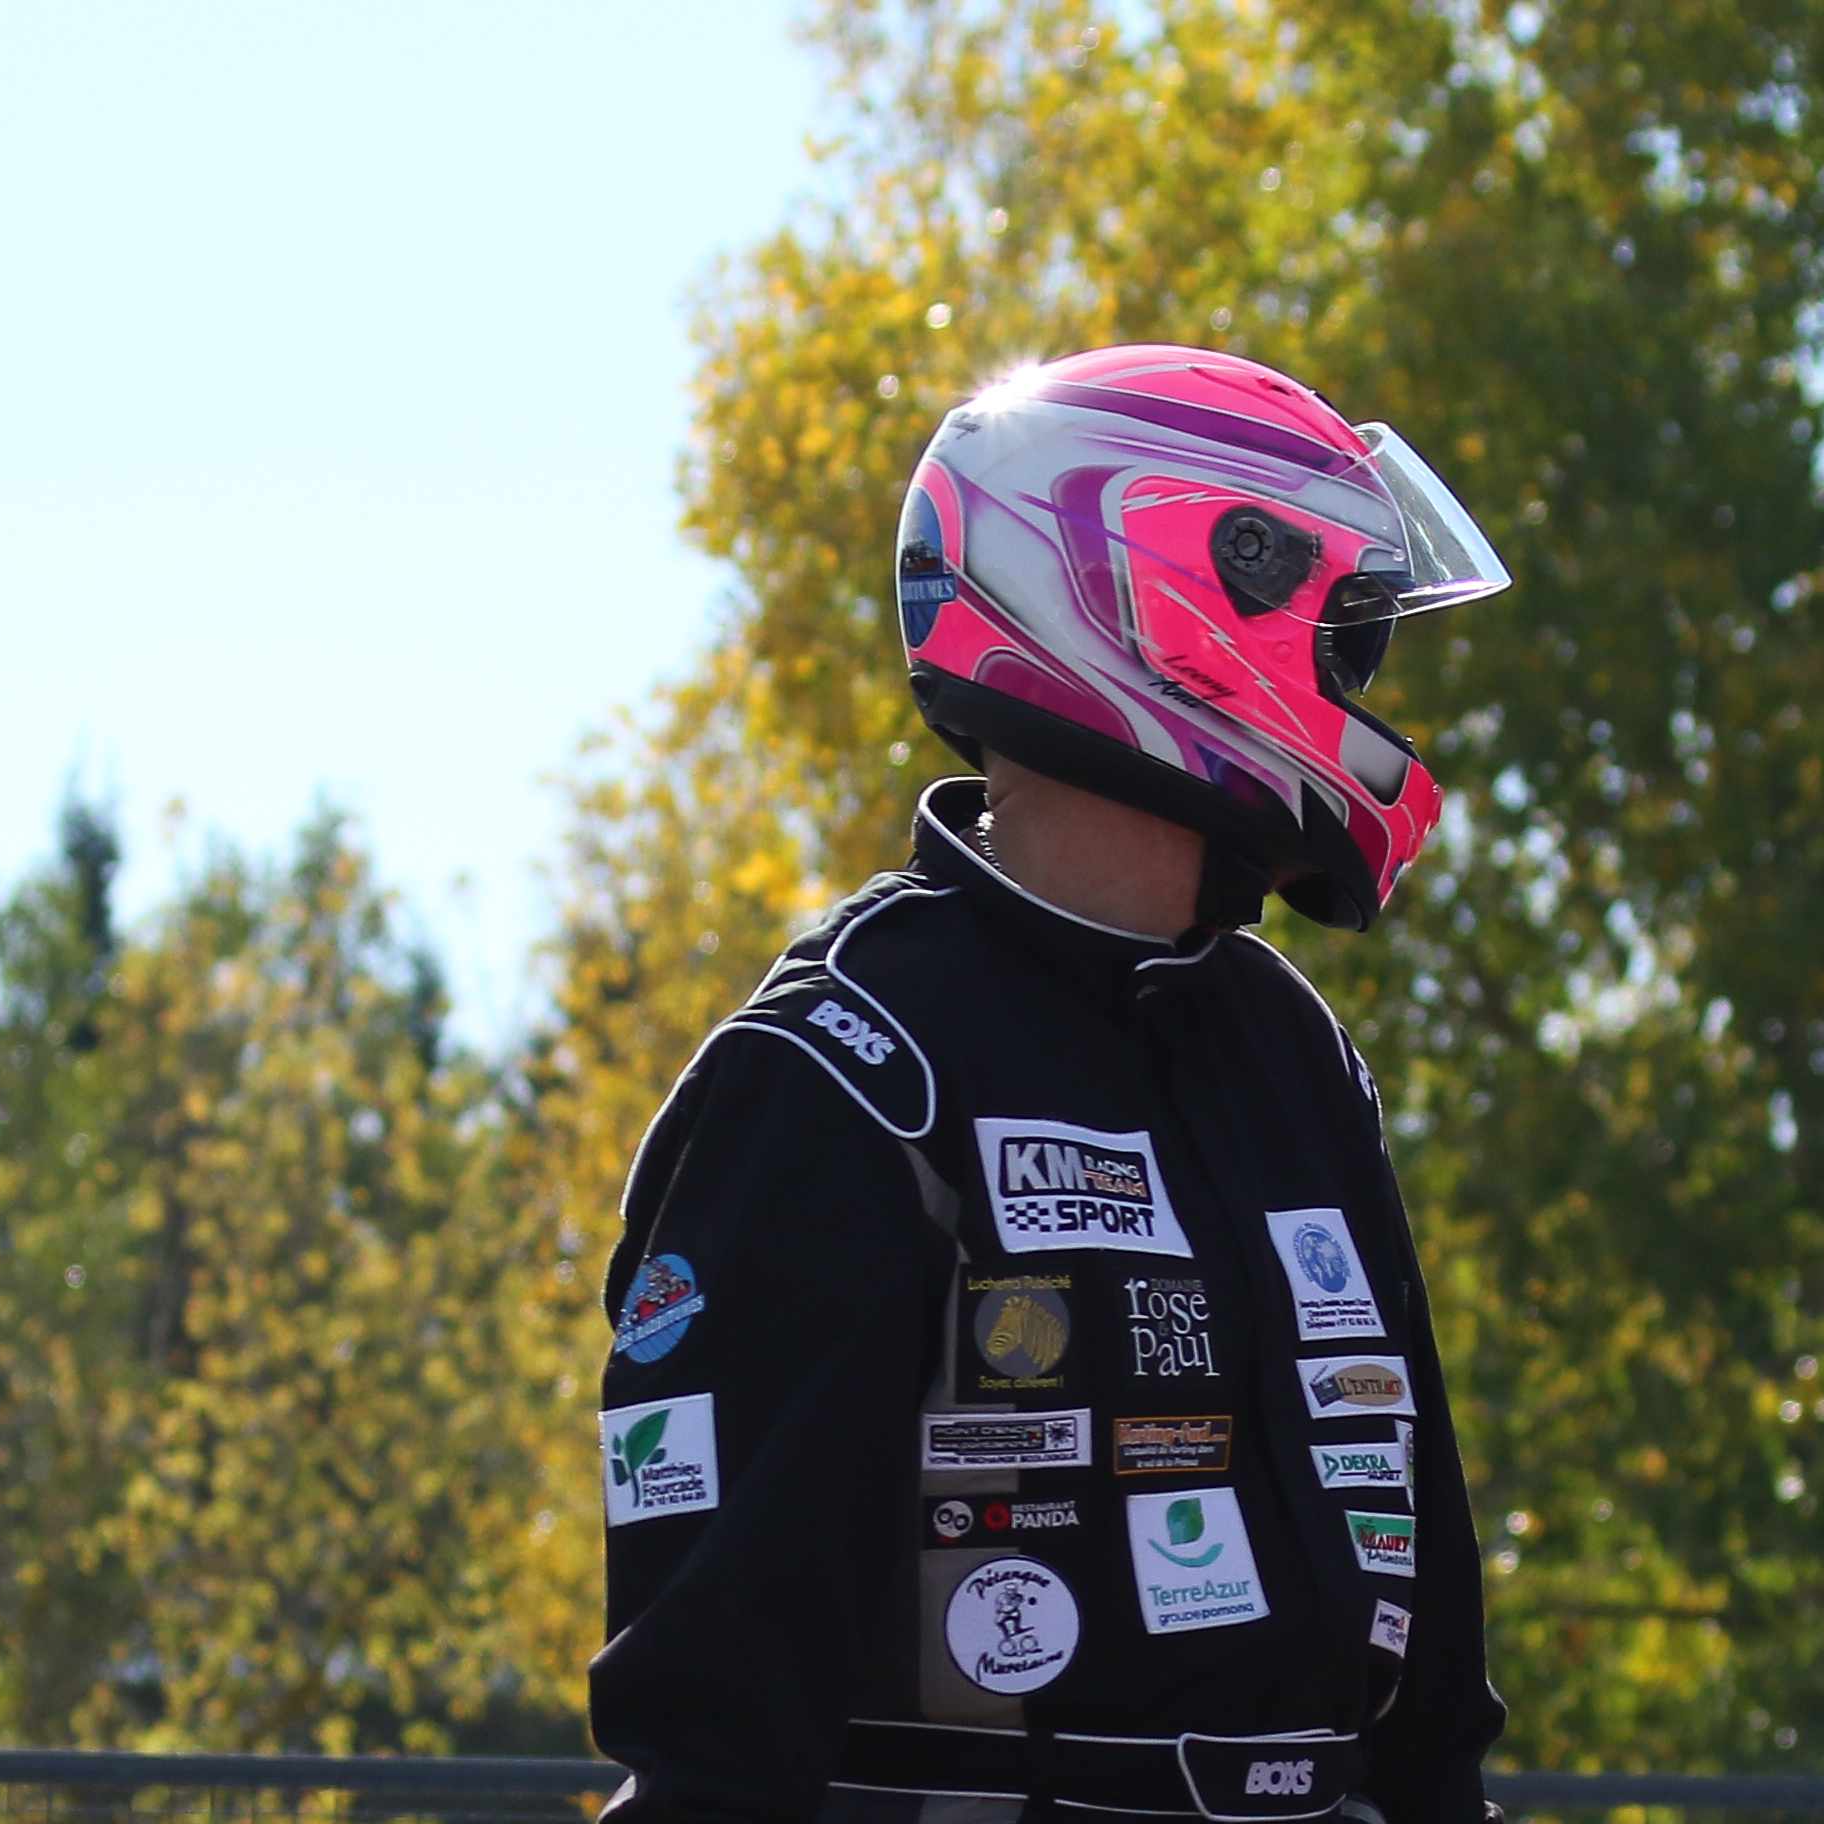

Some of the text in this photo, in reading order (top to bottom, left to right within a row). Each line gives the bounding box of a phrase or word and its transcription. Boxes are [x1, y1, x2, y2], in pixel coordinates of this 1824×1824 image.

[1005, 1143, 1089, 1192] KM
[1084, 1154, 1140, 1180] RACING
[1084, 1170, 1148, 1199] TEAM
[1056, 1200, 1155, 1238] SPORT
[1150, 1278, 1206, 1293] DOMAINE
[1123, 1276, 1210, 1334] rose
[1340, 1455, 1392, 1471] DEKRA
[1011, 1509, 1080, 1529] PANDA
[1146, 1578, 1251, 1606] TerreAzur
